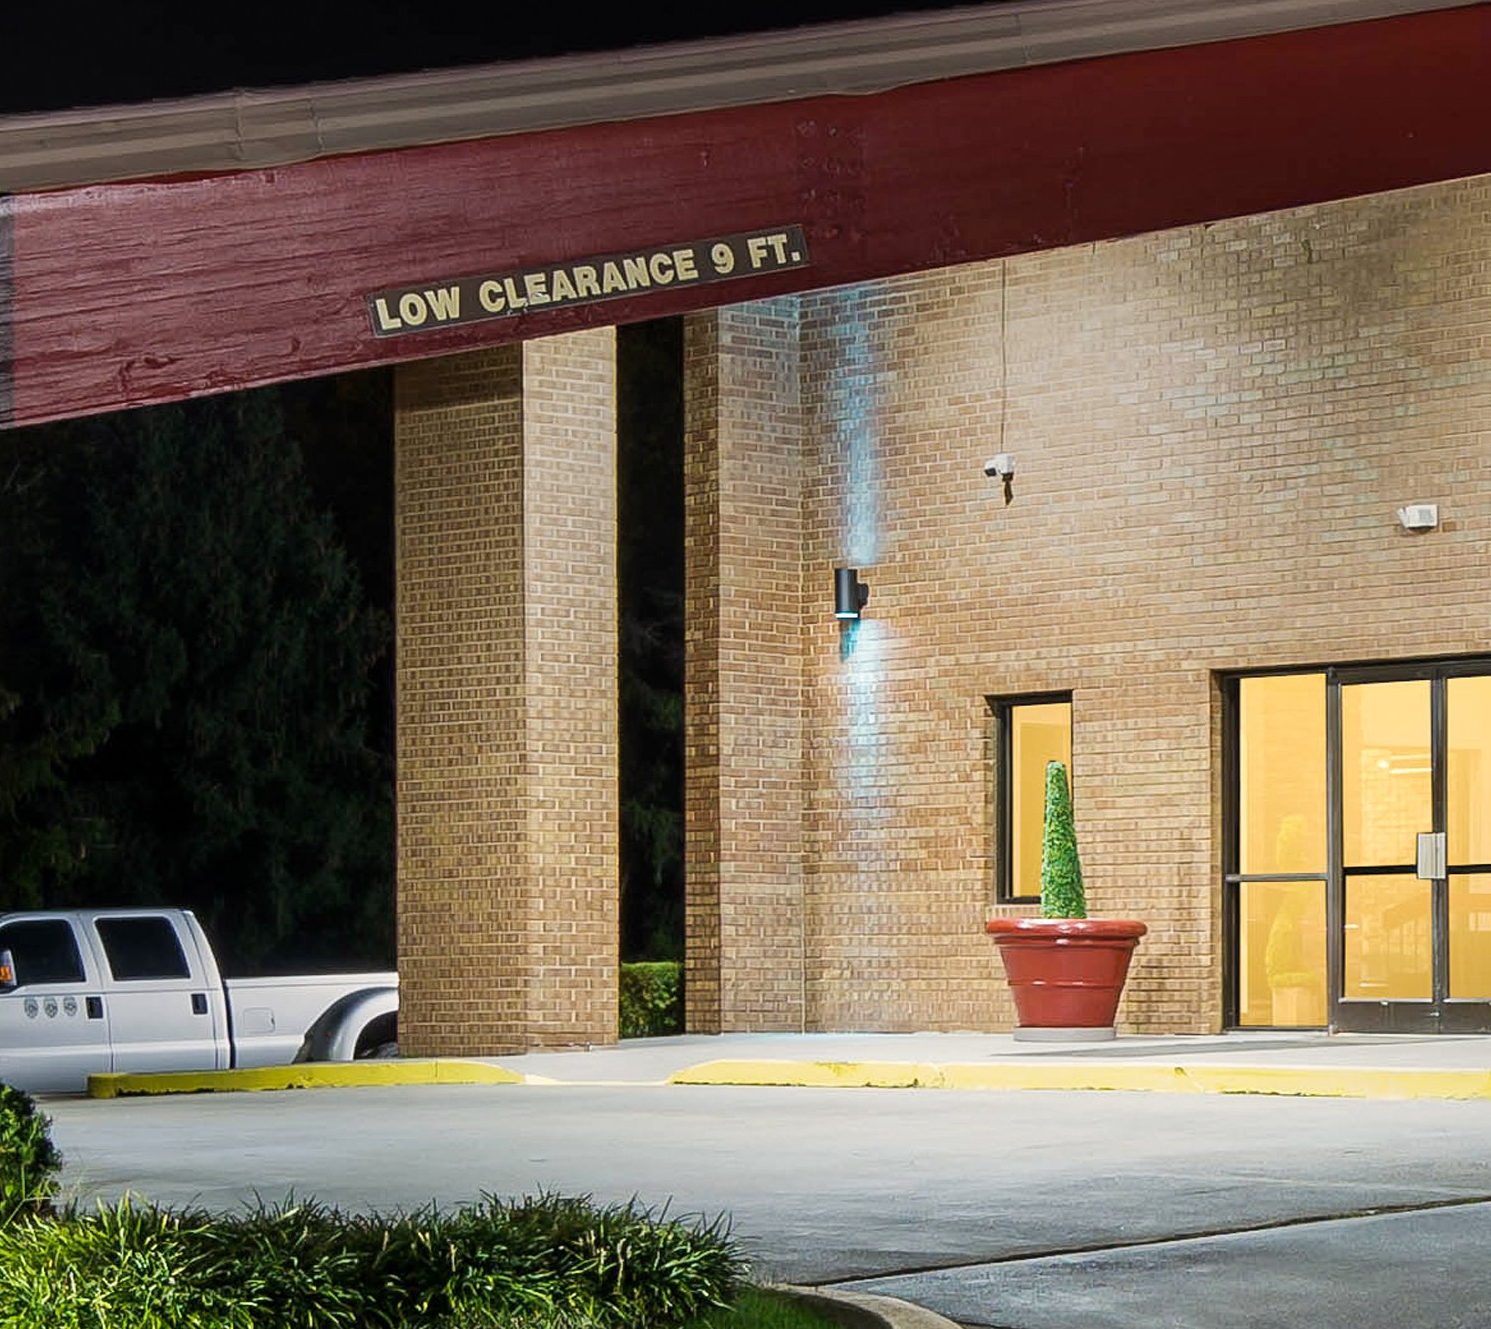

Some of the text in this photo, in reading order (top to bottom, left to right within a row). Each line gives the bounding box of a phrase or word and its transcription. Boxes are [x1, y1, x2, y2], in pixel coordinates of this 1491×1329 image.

[376, 234, 800, 330] LOW CLEARANCE 9 FT.
